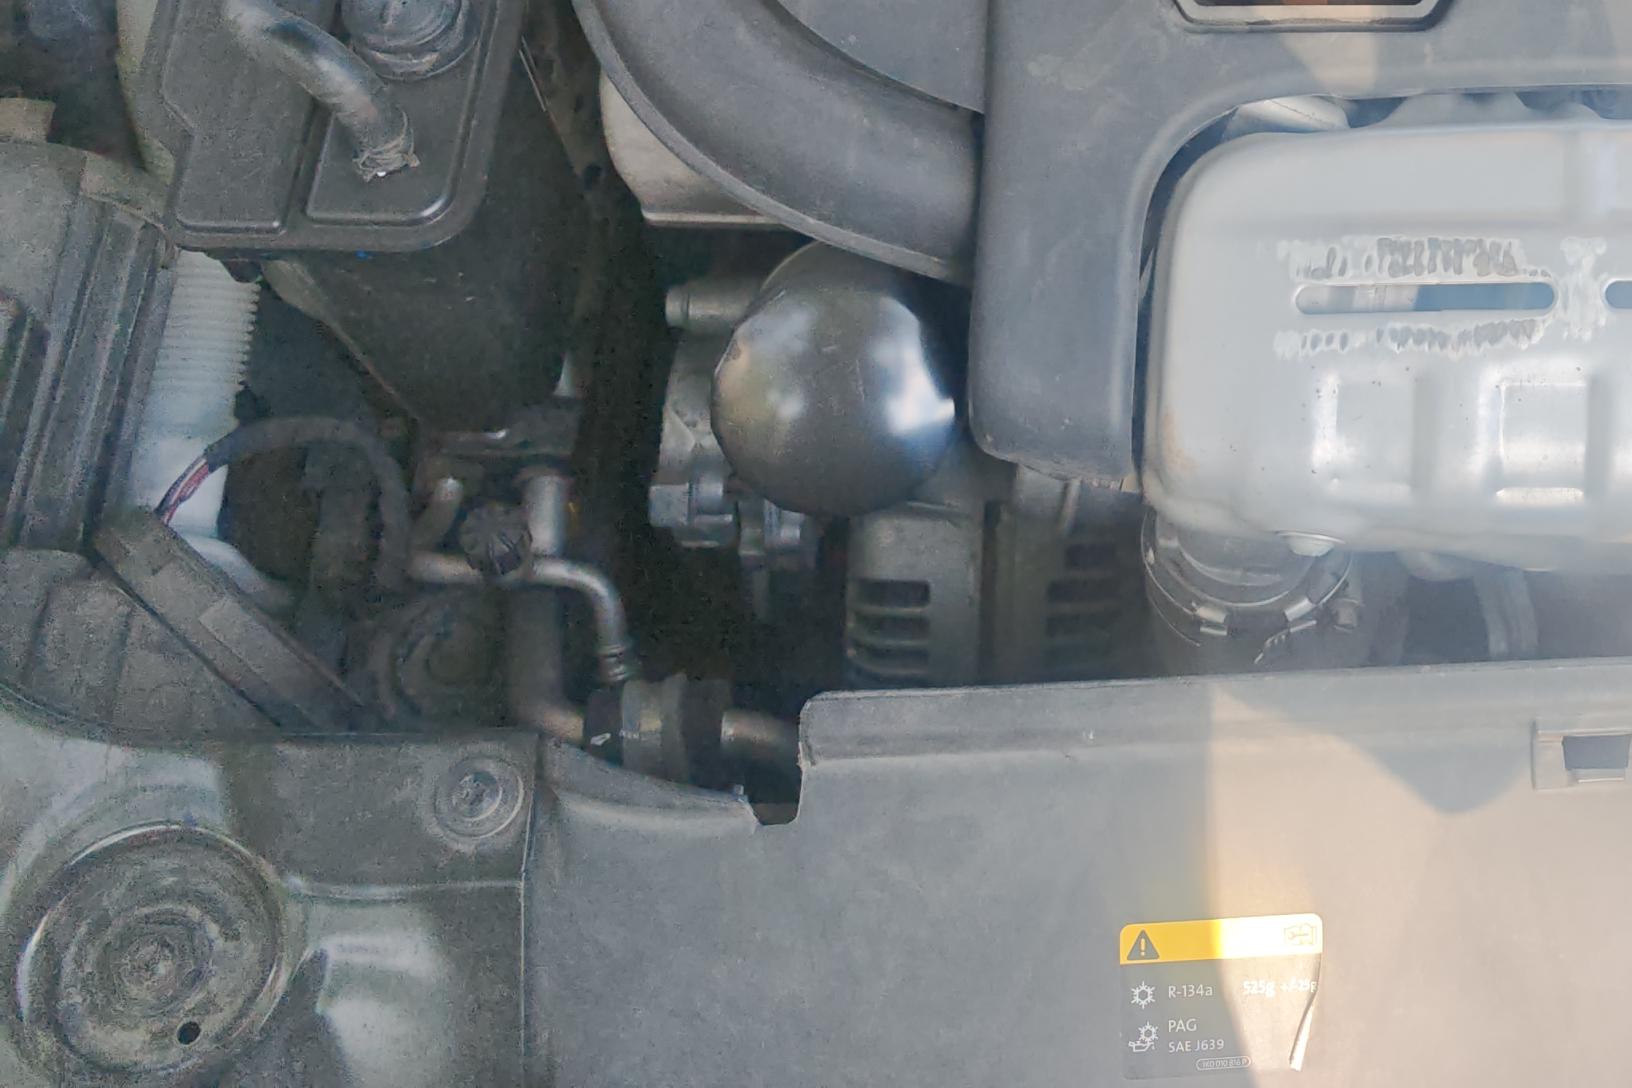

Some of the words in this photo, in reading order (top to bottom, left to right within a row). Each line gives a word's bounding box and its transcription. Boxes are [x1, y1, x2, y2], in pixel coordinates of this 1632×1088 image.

[1168, 983, 1213, 999] R-134a
[1242, 979, 1277, 999] 525g
[1168, 1018, 1198, 1033] PAG
[1168, 1040, 1191, 1053] SAE
[1195, 1038, 1225, 1052] J639
